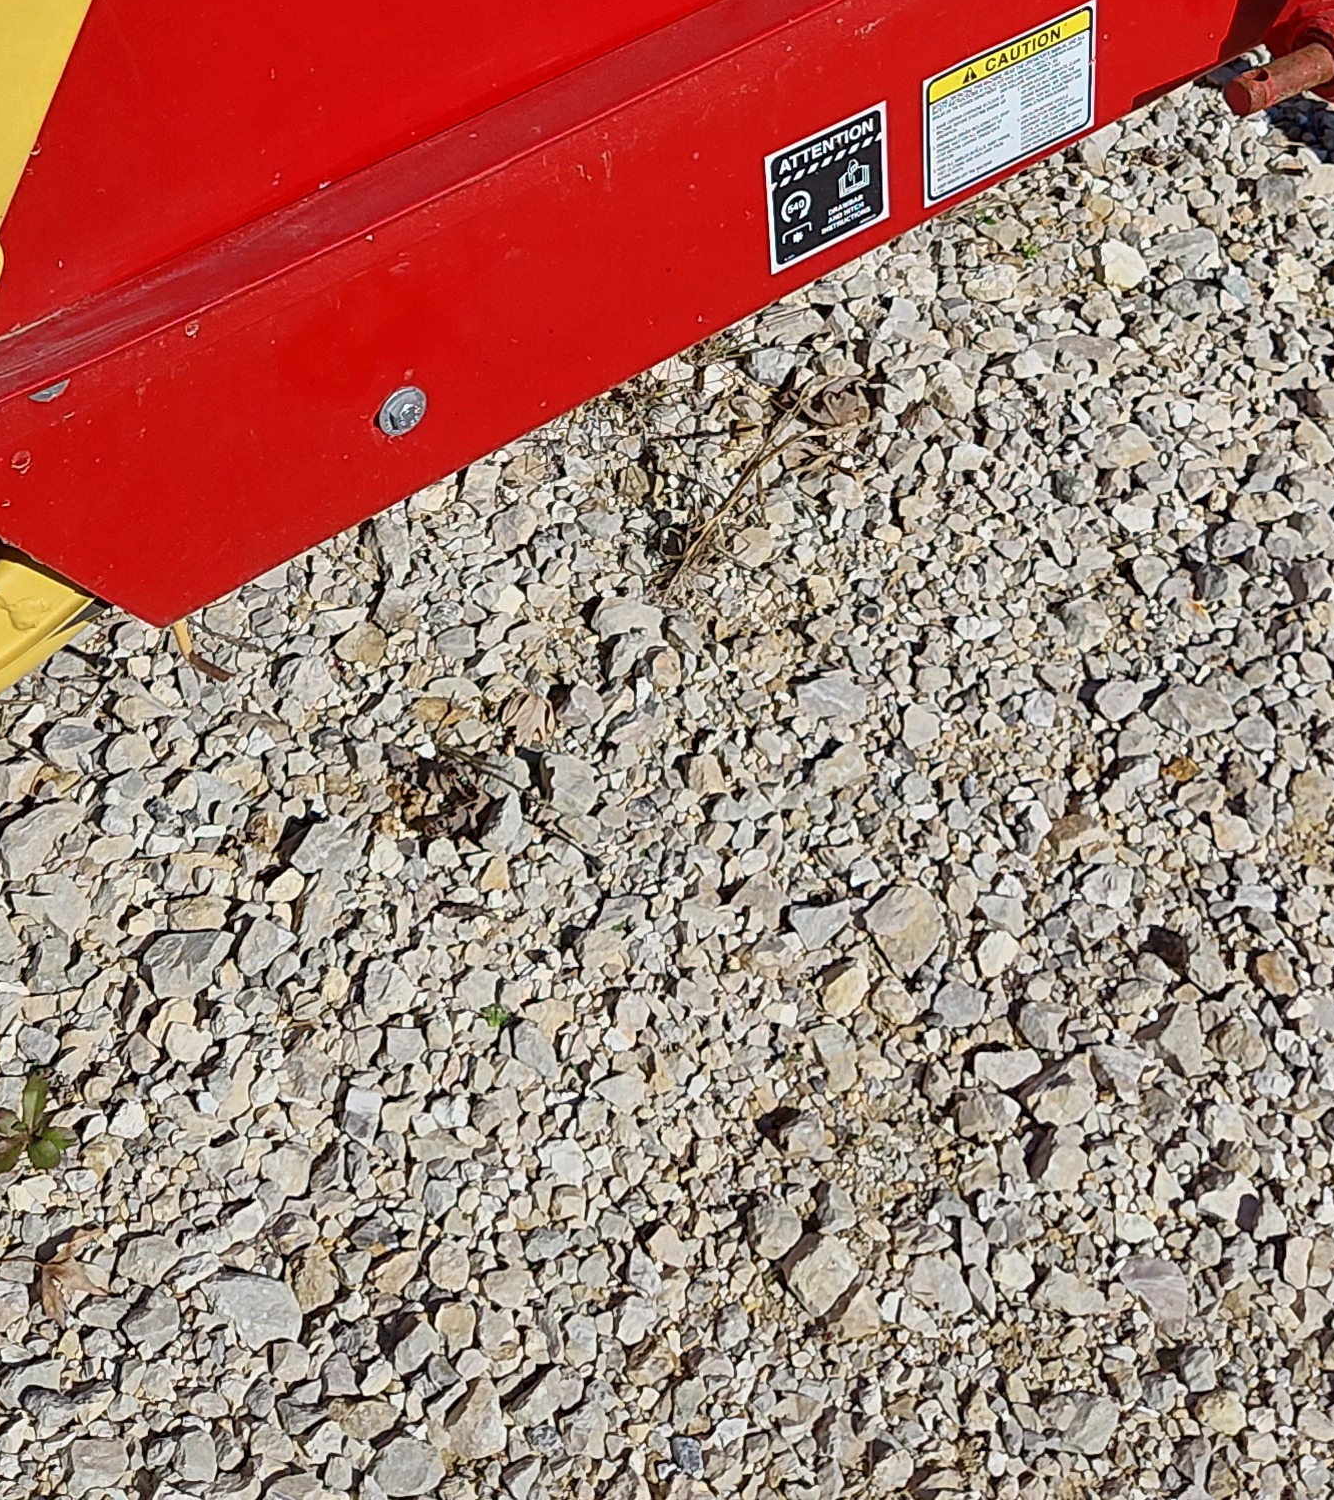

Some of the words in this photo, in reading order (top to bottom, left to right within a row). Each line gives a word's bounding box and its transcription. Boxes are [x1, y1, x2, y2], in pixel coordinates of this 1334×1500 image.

[985, 26, 1061, 72] CAUTION
[779, 118, 874, 175] ATTENTION
[787, 199, 805, 214] 540
[828, 194, 864, 216] DRAWBAR
[828, 210, 843, 224] AND
[843, 202, 865, 219] HITCH
[821, 206, 871, 235] INSTRUCTIONS
